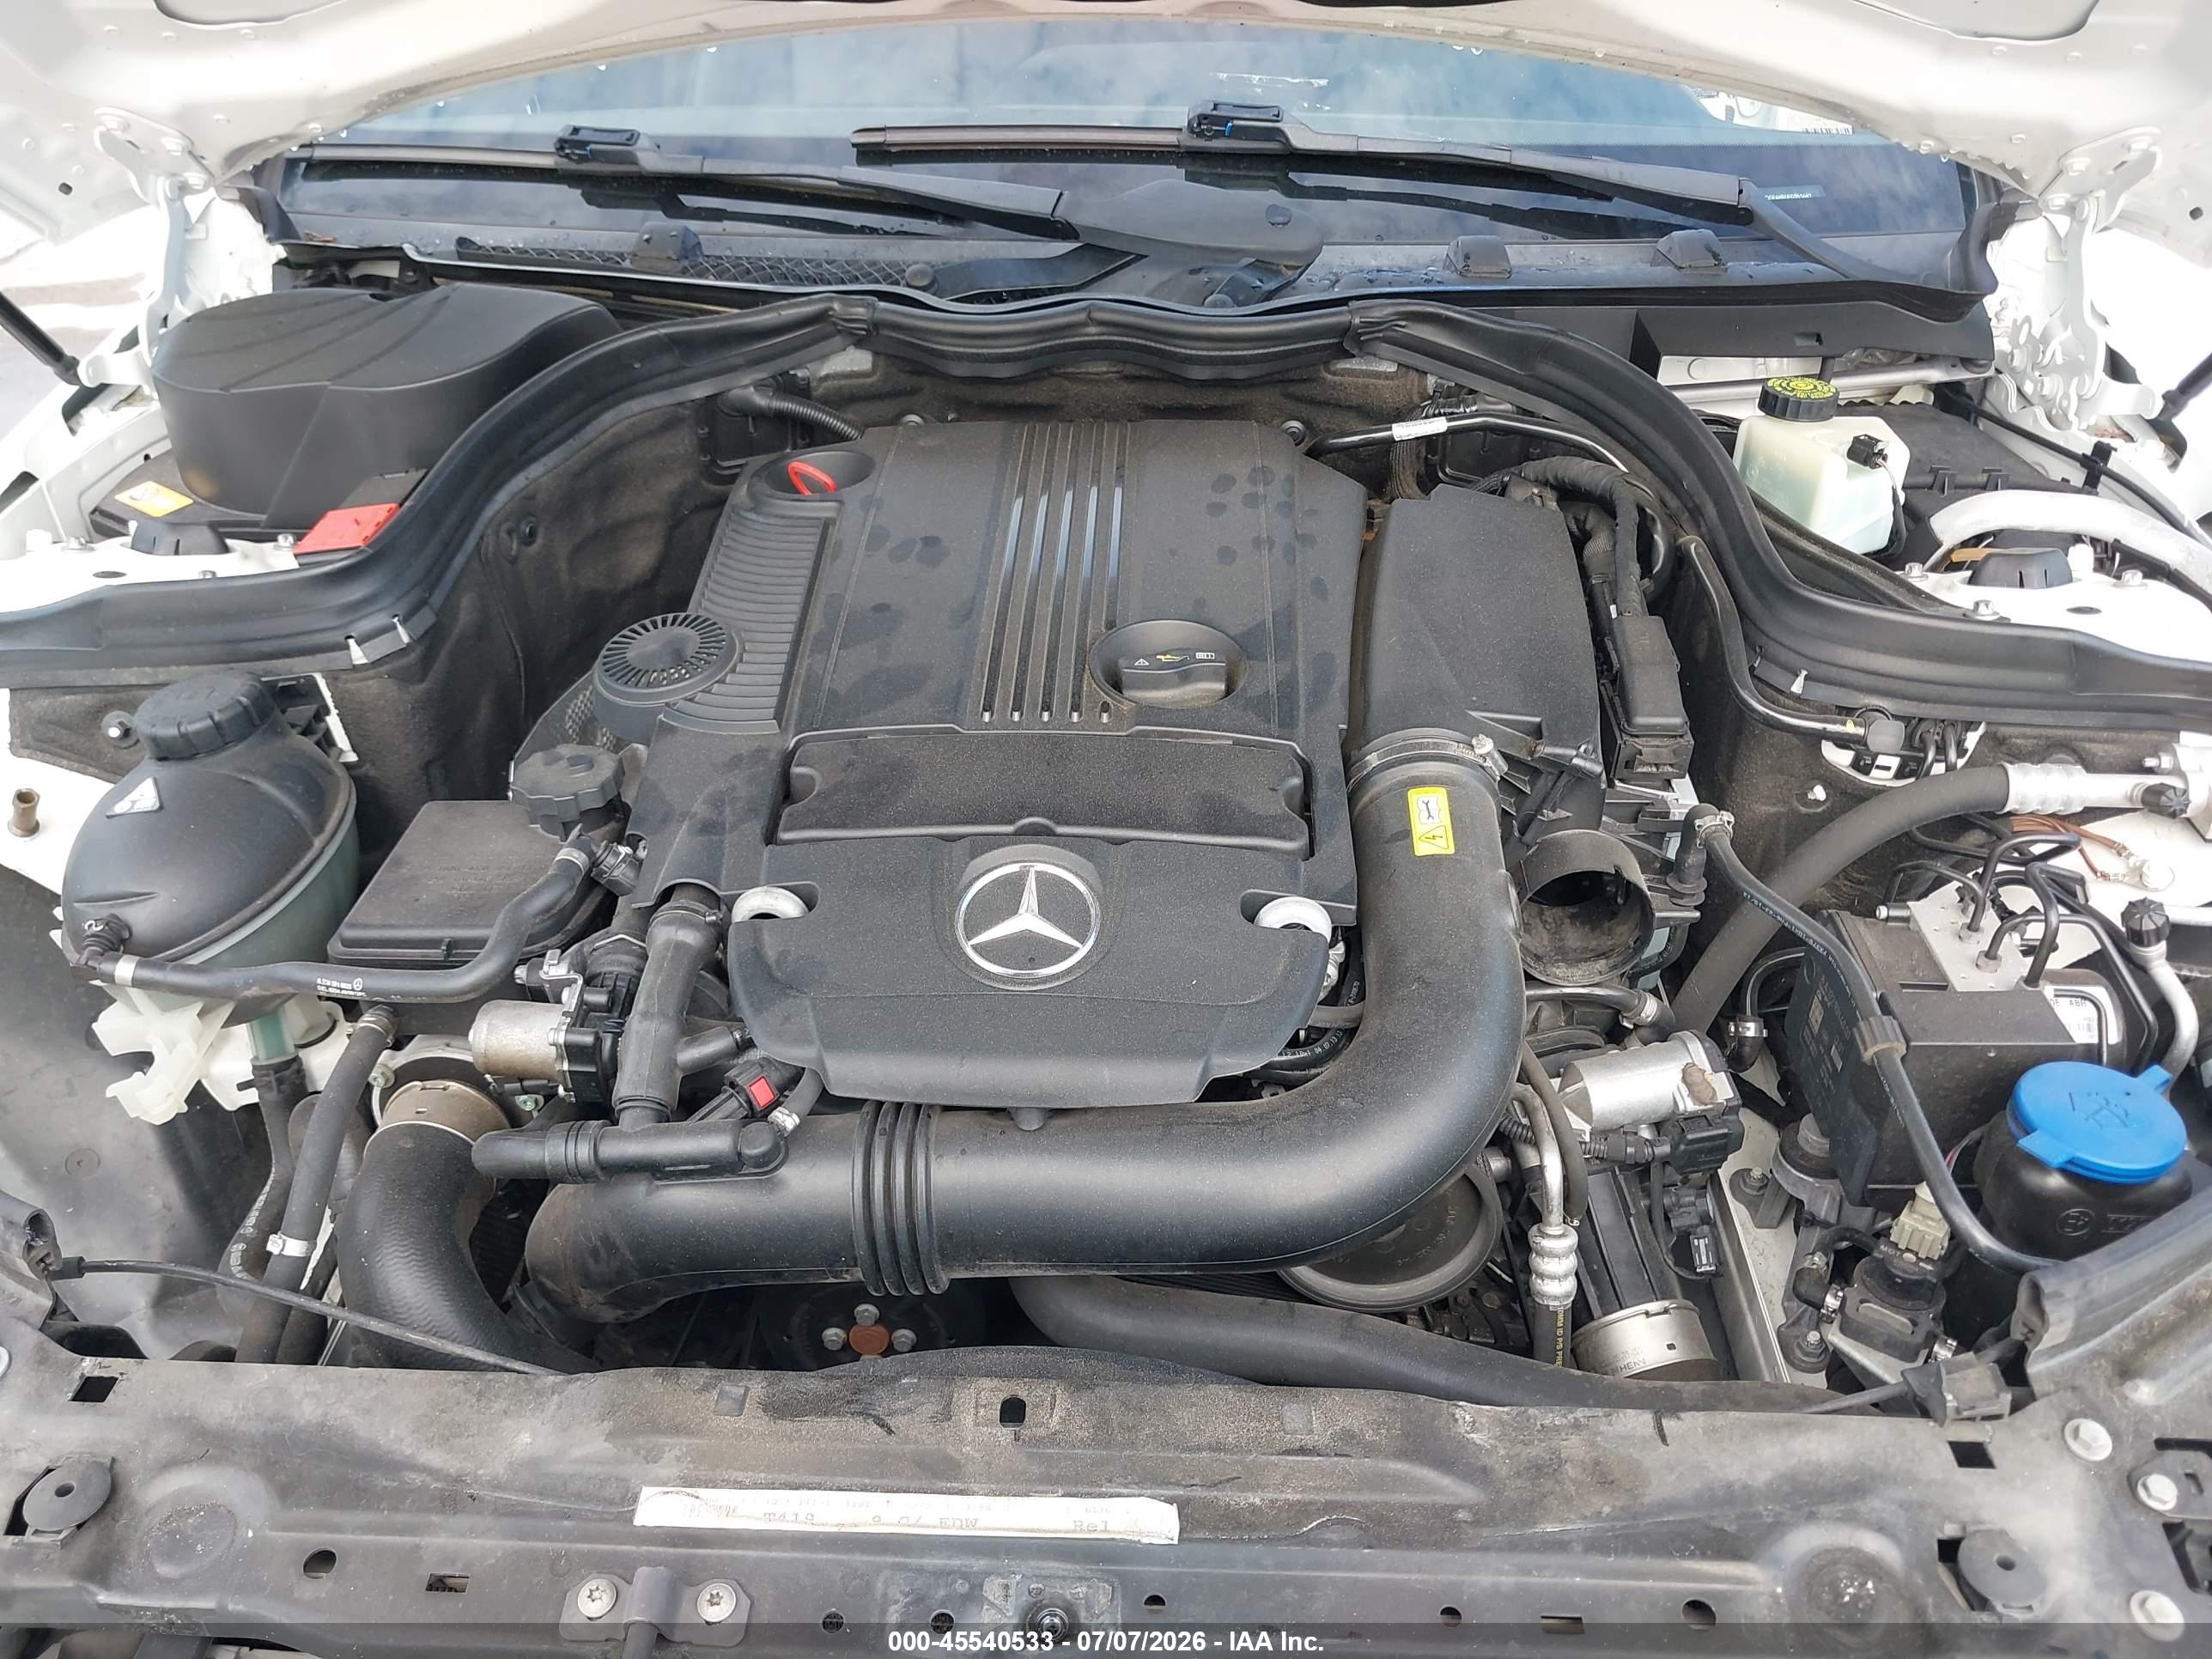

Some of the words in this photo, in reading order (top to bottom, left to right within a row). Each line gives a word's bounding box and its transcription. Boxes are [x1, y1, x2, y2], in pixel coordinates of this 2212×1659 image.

[1880, 1244, 1901, 1257] MOT
[1556, 1328, 1565, 1336] ID
[1555, 1337, 1564, 1351] P/S
